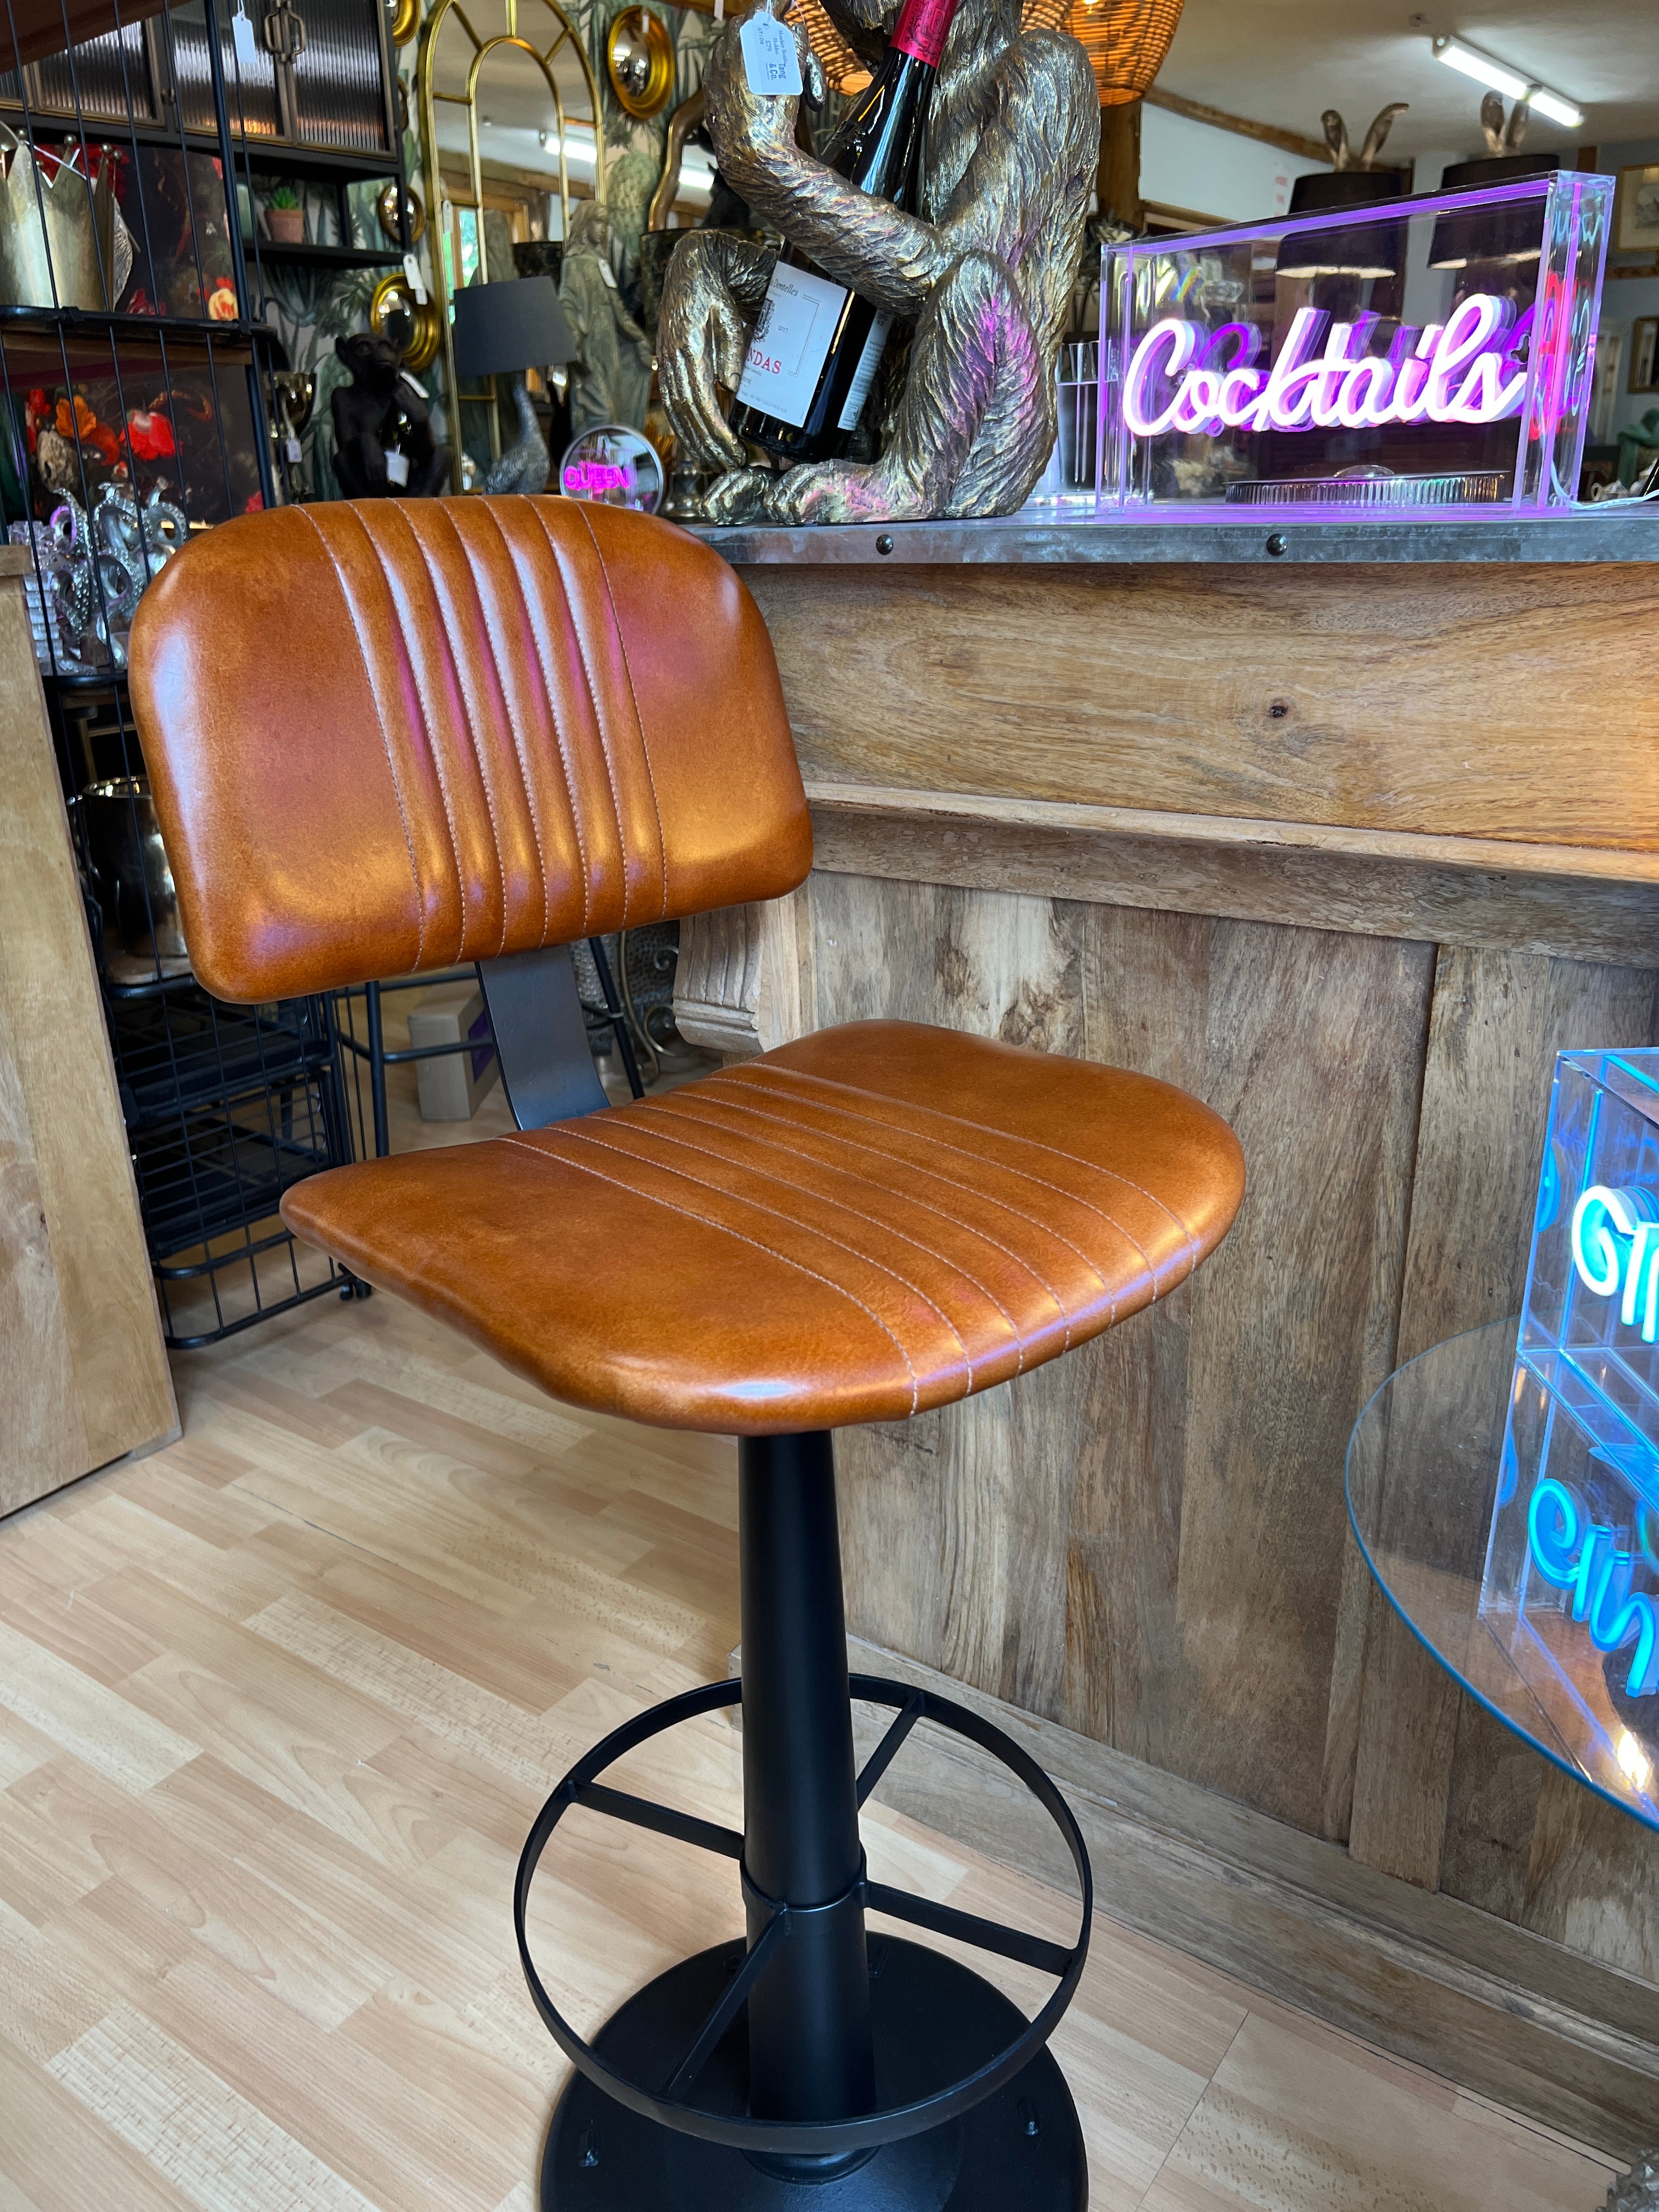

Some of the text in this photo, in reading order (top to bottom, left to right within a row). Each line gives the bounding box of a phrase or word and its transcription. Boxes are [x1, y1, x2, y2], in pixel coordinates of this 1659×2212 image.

[778, 63, 786, 80] Tang
[773, 279, 799, 297] Dentelles
[1122, 294, 1528, 437] Cocktails
